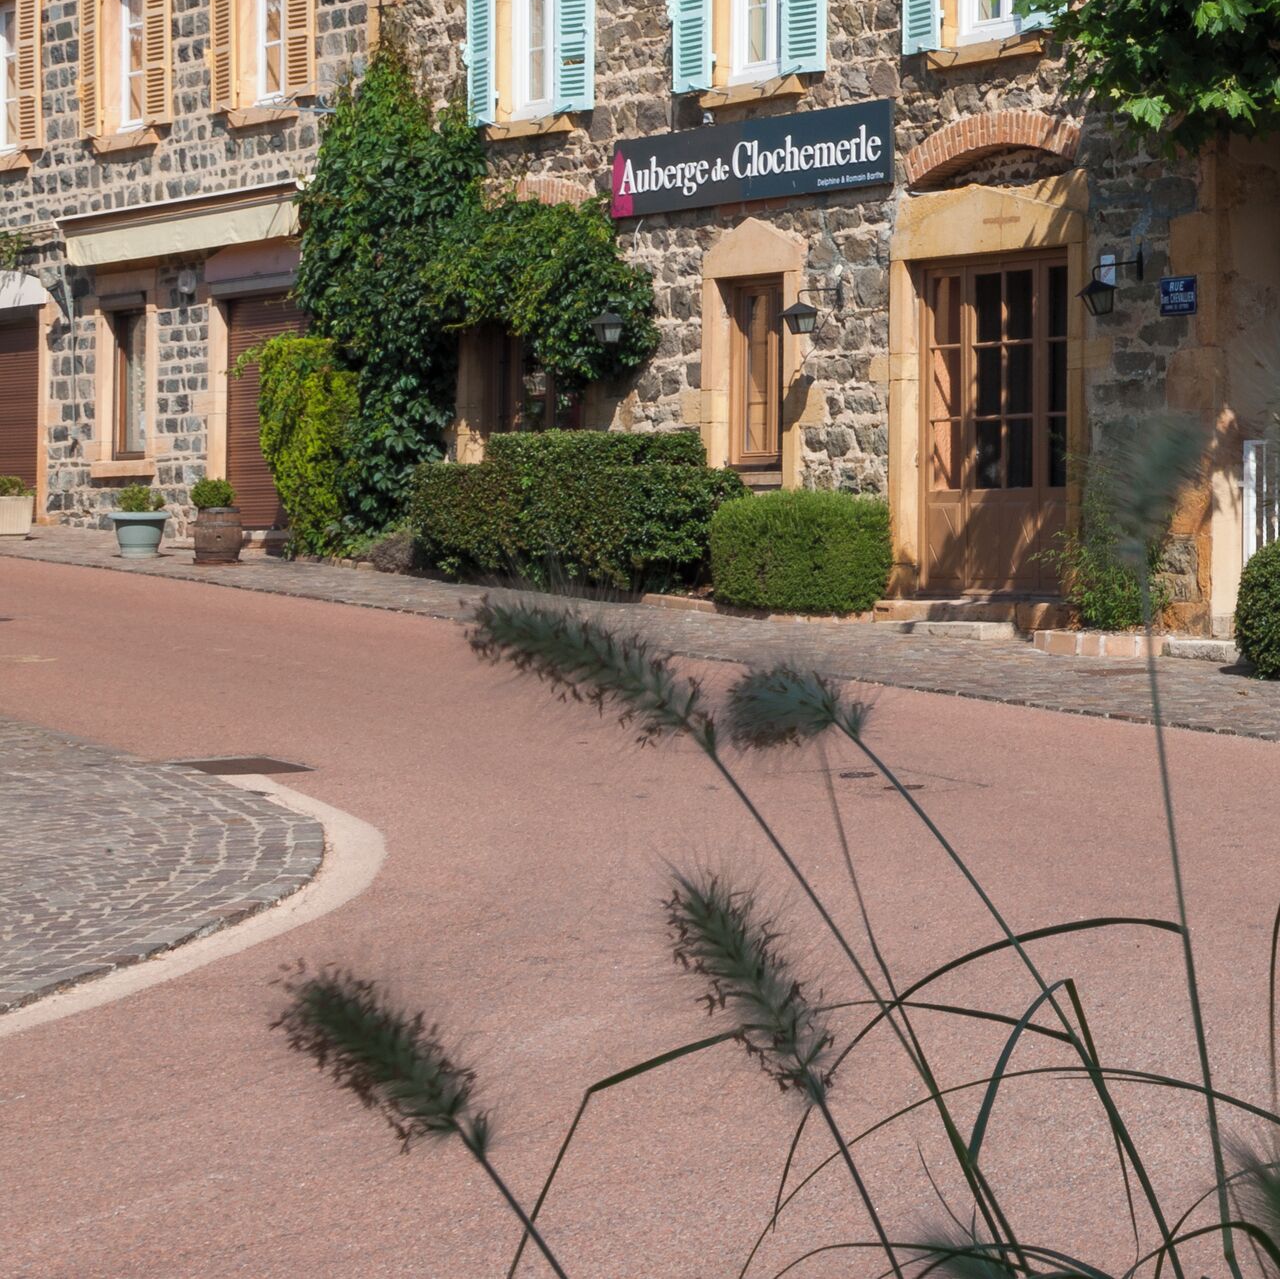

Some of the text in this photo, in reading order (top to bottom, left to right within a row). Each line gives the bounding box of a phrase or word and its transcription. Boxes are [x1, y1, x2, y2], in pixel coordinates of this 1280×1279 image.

[618, 124, 883, 197] Auberge de Clochemerle
[817, 178, 840, 187] Delphine
[1169, 281, 1184, 291] RUE
